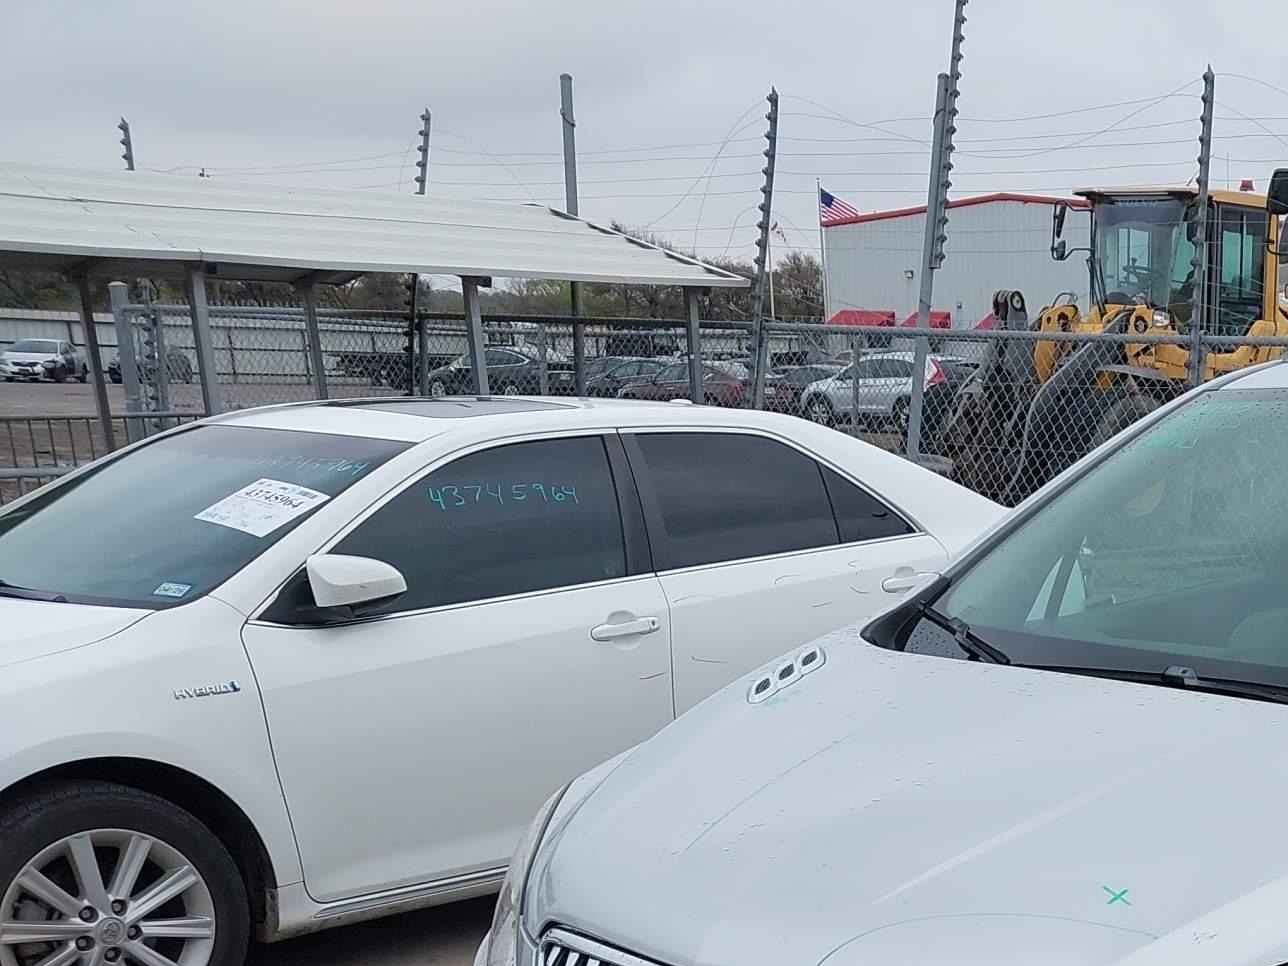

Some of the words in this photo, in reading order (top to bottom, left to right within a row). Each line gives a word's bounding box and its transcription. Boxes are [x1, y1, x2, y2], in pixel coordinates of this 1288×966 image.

[244, 488, 305, 510] 43745964
[428, 483, 579, 510] 43745964
[172, 683, 229, 700] HYBRID
